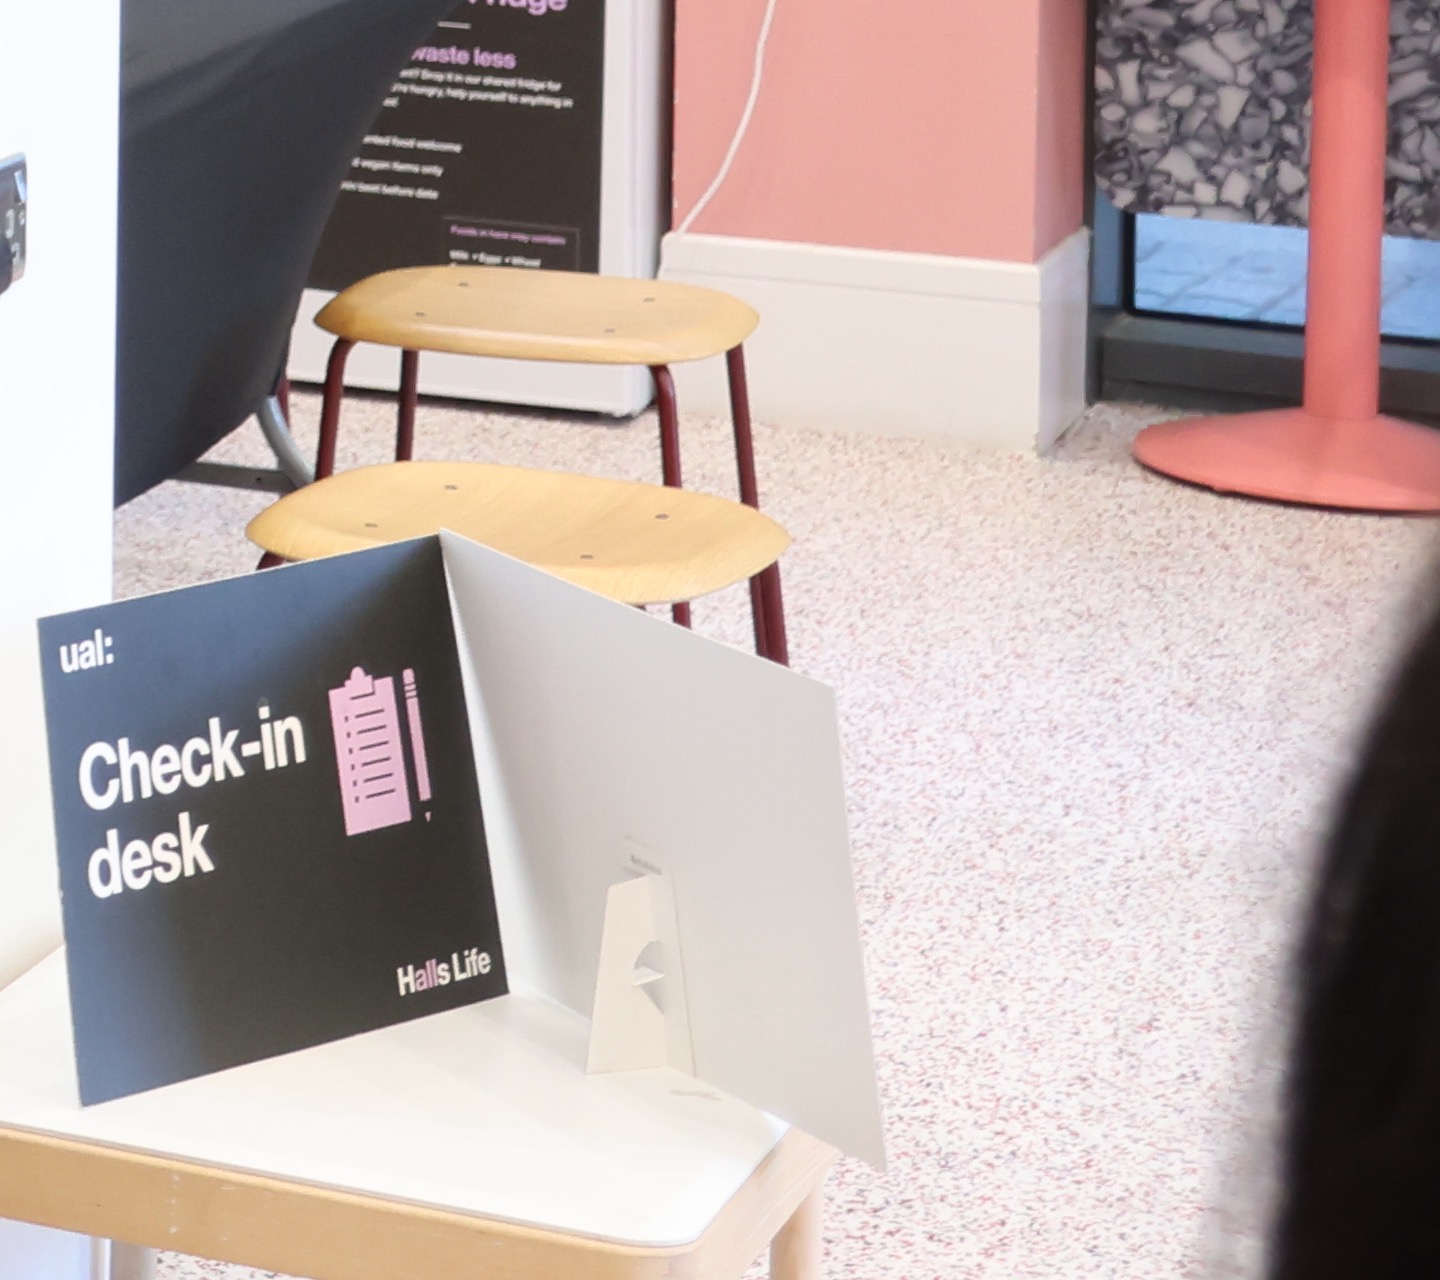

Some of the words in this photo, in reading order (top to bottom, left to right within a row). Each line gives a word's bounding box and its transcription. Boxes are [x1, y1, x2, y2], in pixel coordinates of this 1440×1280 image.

[474, 47, 517, 70] less
[60, 629, 115, 673] ual:
[79, 705, 307, 811] Check-in
[88, 811, 215, 899] desk
[397, 958, 451, 996] Halls
[452, 947, 491, 982] Life
